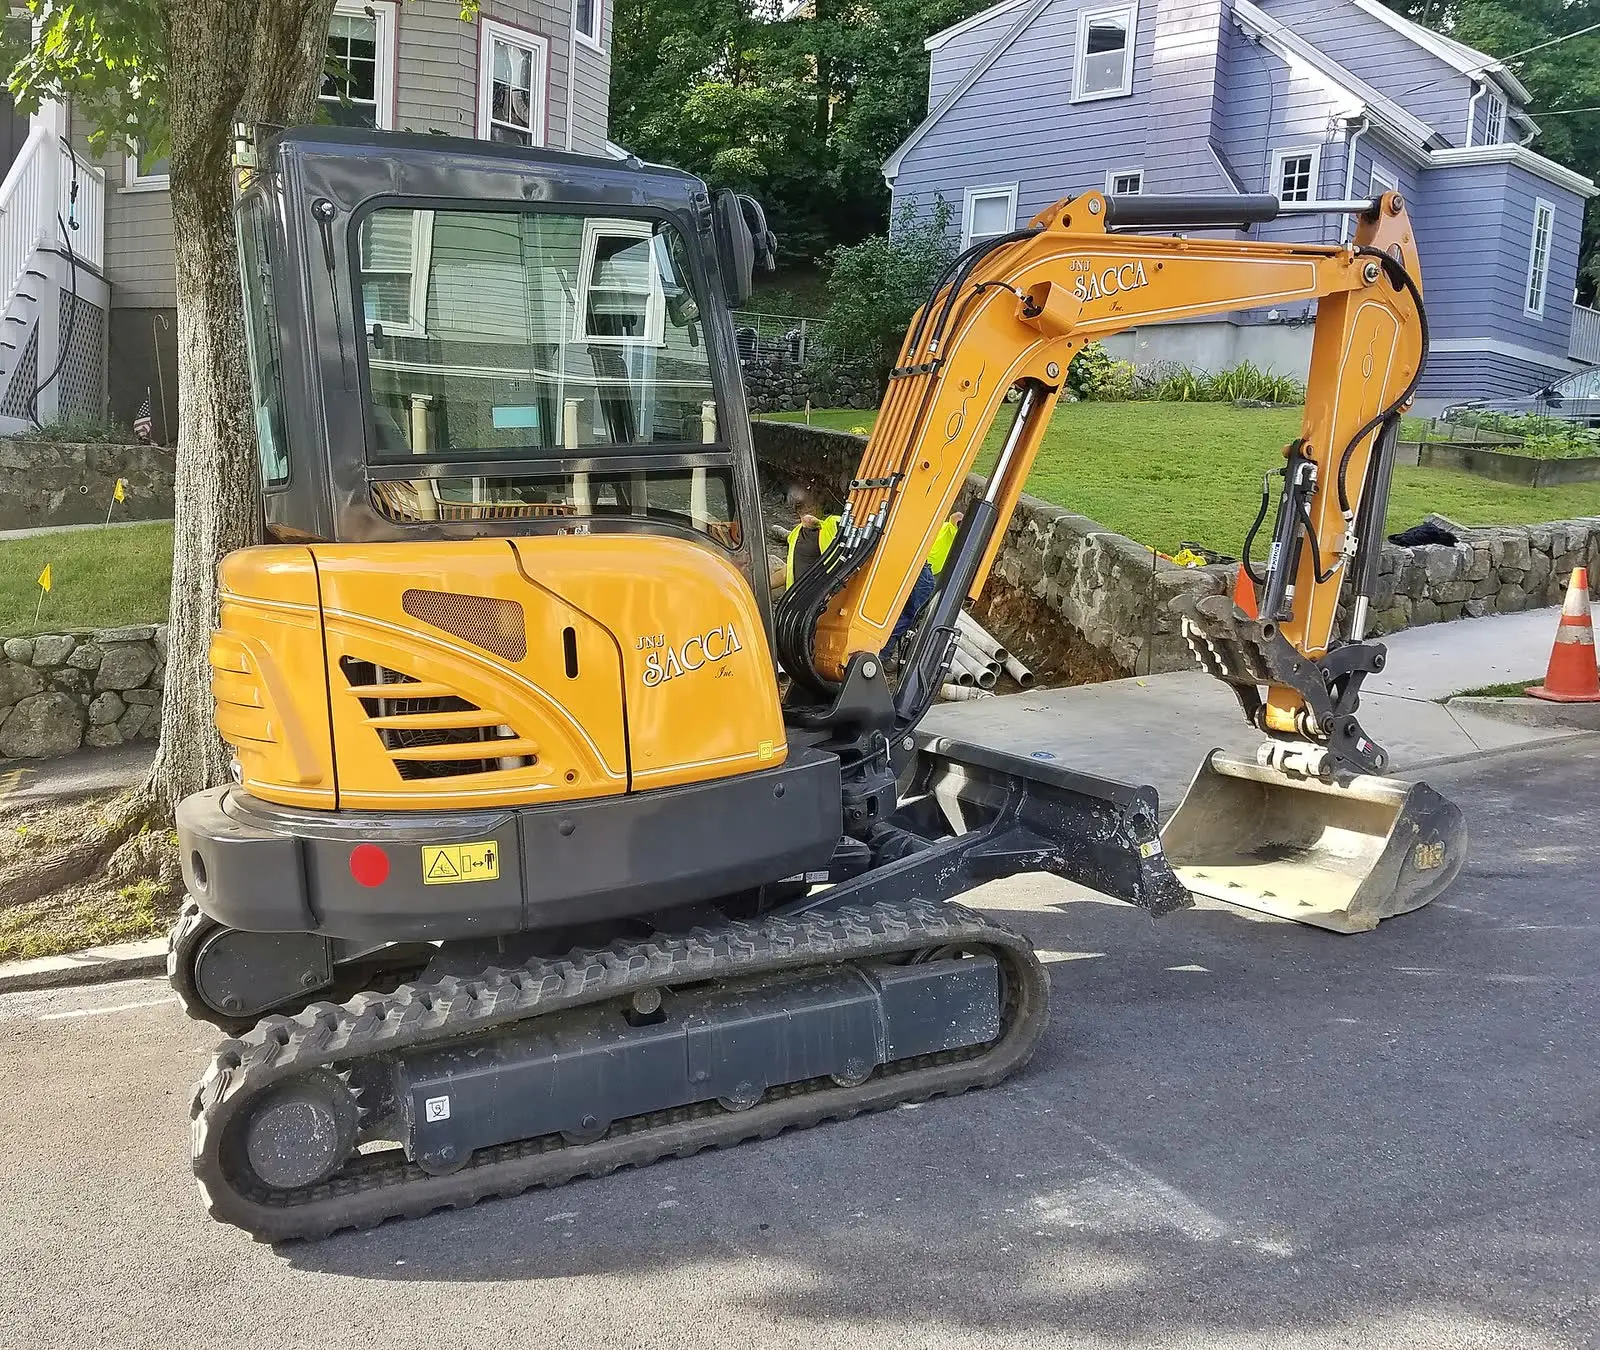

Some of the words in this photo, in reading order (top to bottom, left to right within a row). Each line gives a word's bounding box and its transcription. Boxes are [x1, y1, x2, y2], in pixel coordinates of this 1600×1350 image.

[1069, 260, 1091, 271] JNJ
[1073, 260, 1149, 303] SACCA
[635, 634, 665, 651] JNJ
[642, 622, 743, 688] SACCA
[714, 664, 734, 679] Inc.
